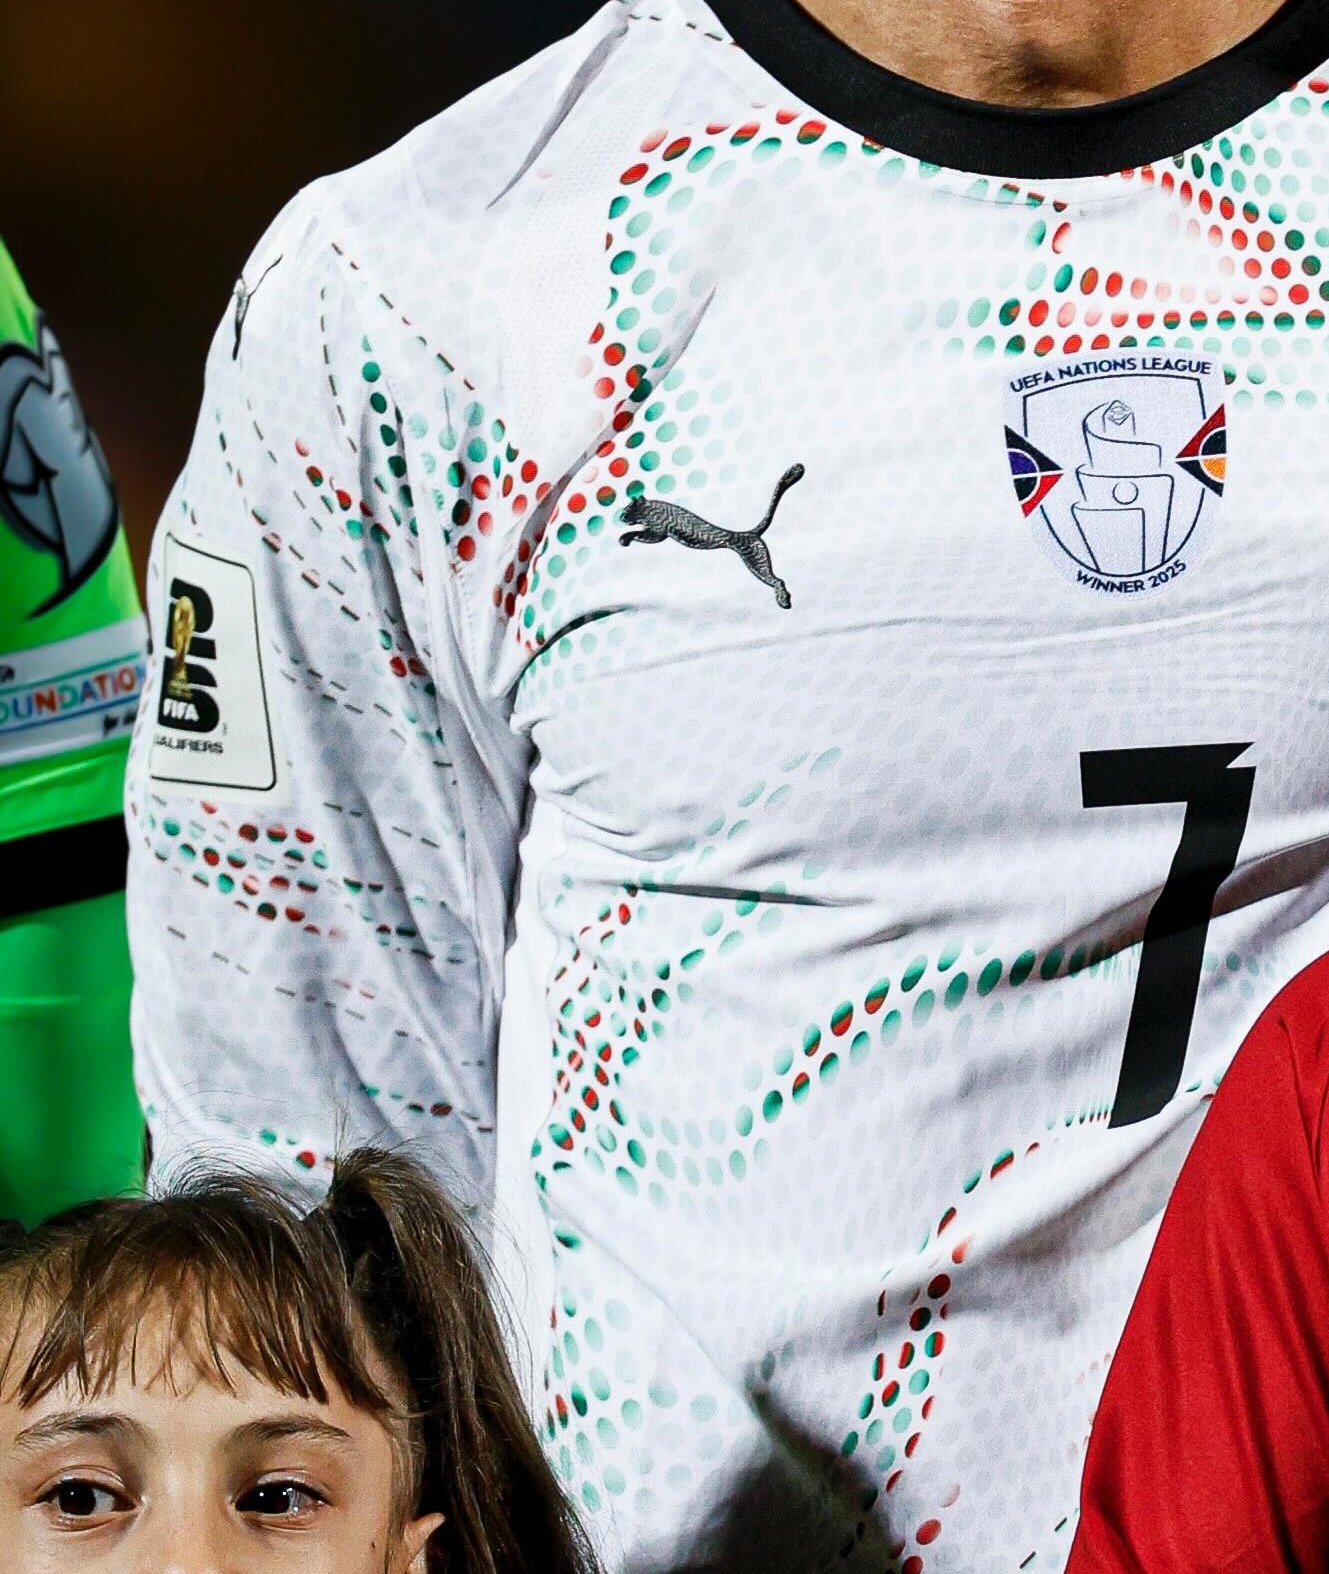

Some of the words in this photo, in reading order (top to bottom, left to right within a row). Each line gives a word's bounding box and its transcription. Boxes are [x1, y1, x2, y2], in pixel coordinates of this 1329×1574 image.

[1010, 372, 1055, 393] UEFA
[1058, 357, 1138, 379] NATIONS
[1141, 357, 1212, 375] LEAGUE
[1076, 569, 1145, 594] WINNER
[1148, 559, 1187, 589] 2025
[163, 697, 200, 722] FIFA
[1079, 741, 1256, 1129] 7
